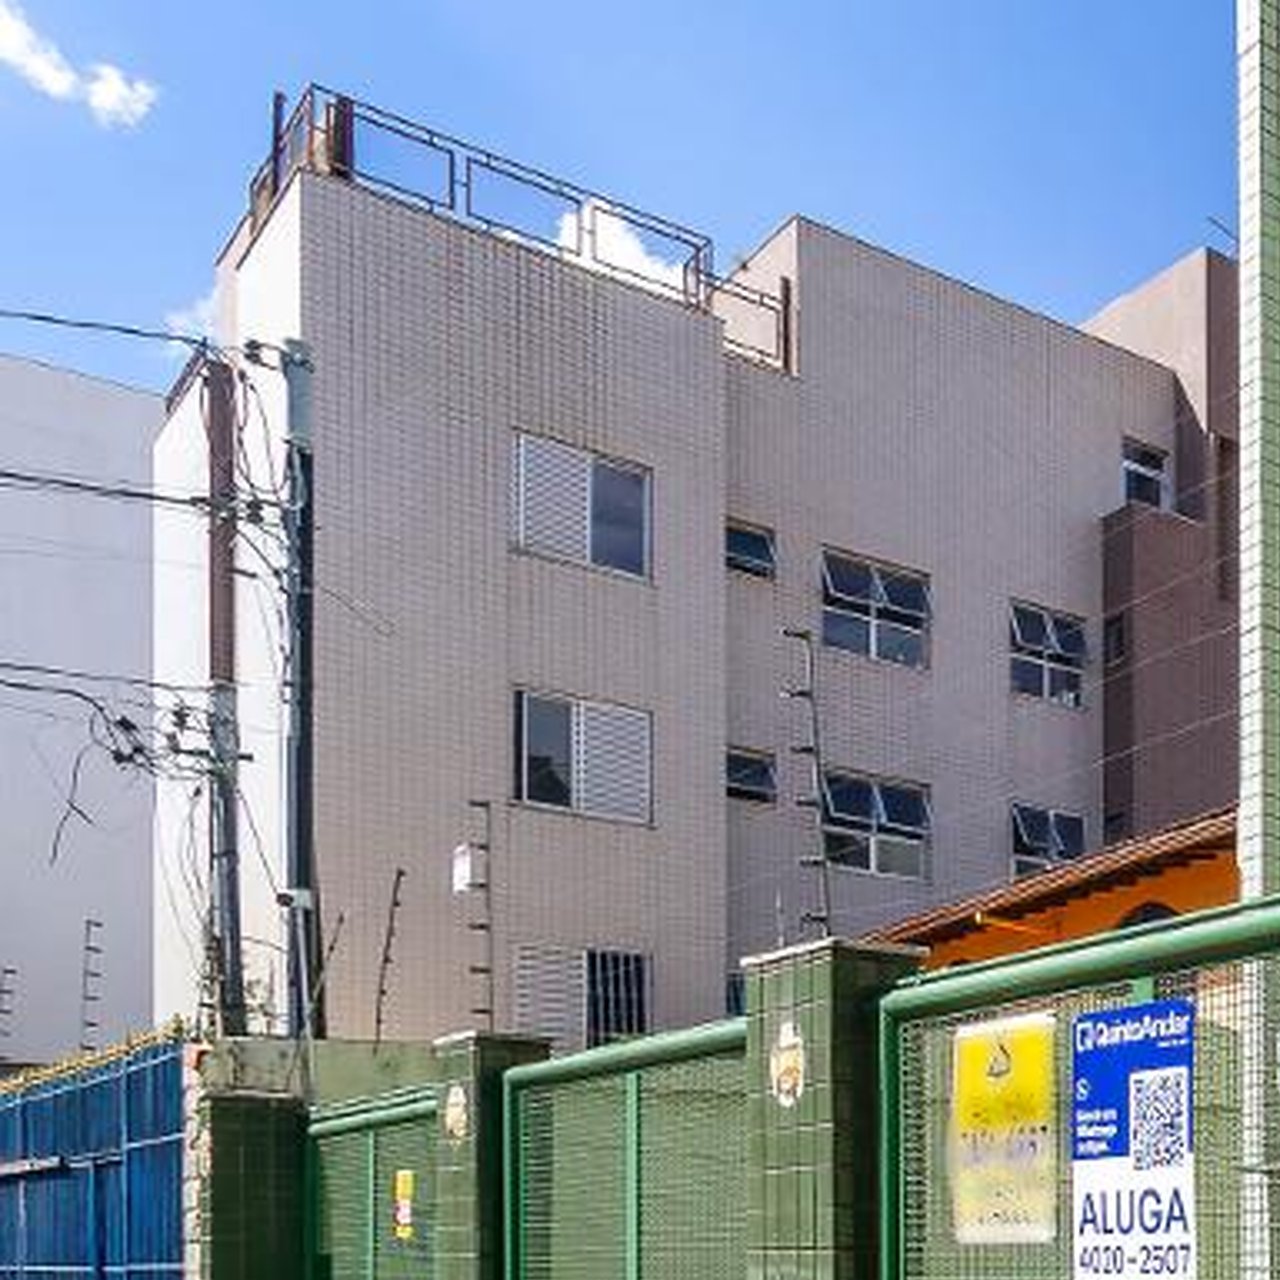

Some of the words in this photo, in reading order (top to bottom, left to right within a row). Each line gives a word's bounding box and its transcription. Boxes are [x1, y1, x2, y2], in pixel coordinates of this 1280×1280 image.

[1096, 1010, 1191, 1047] QuintoAndar
[1079, 1187, 1189, 1235] ALUGA
[1079, 1243, 1191, 1275] 4020-2507
